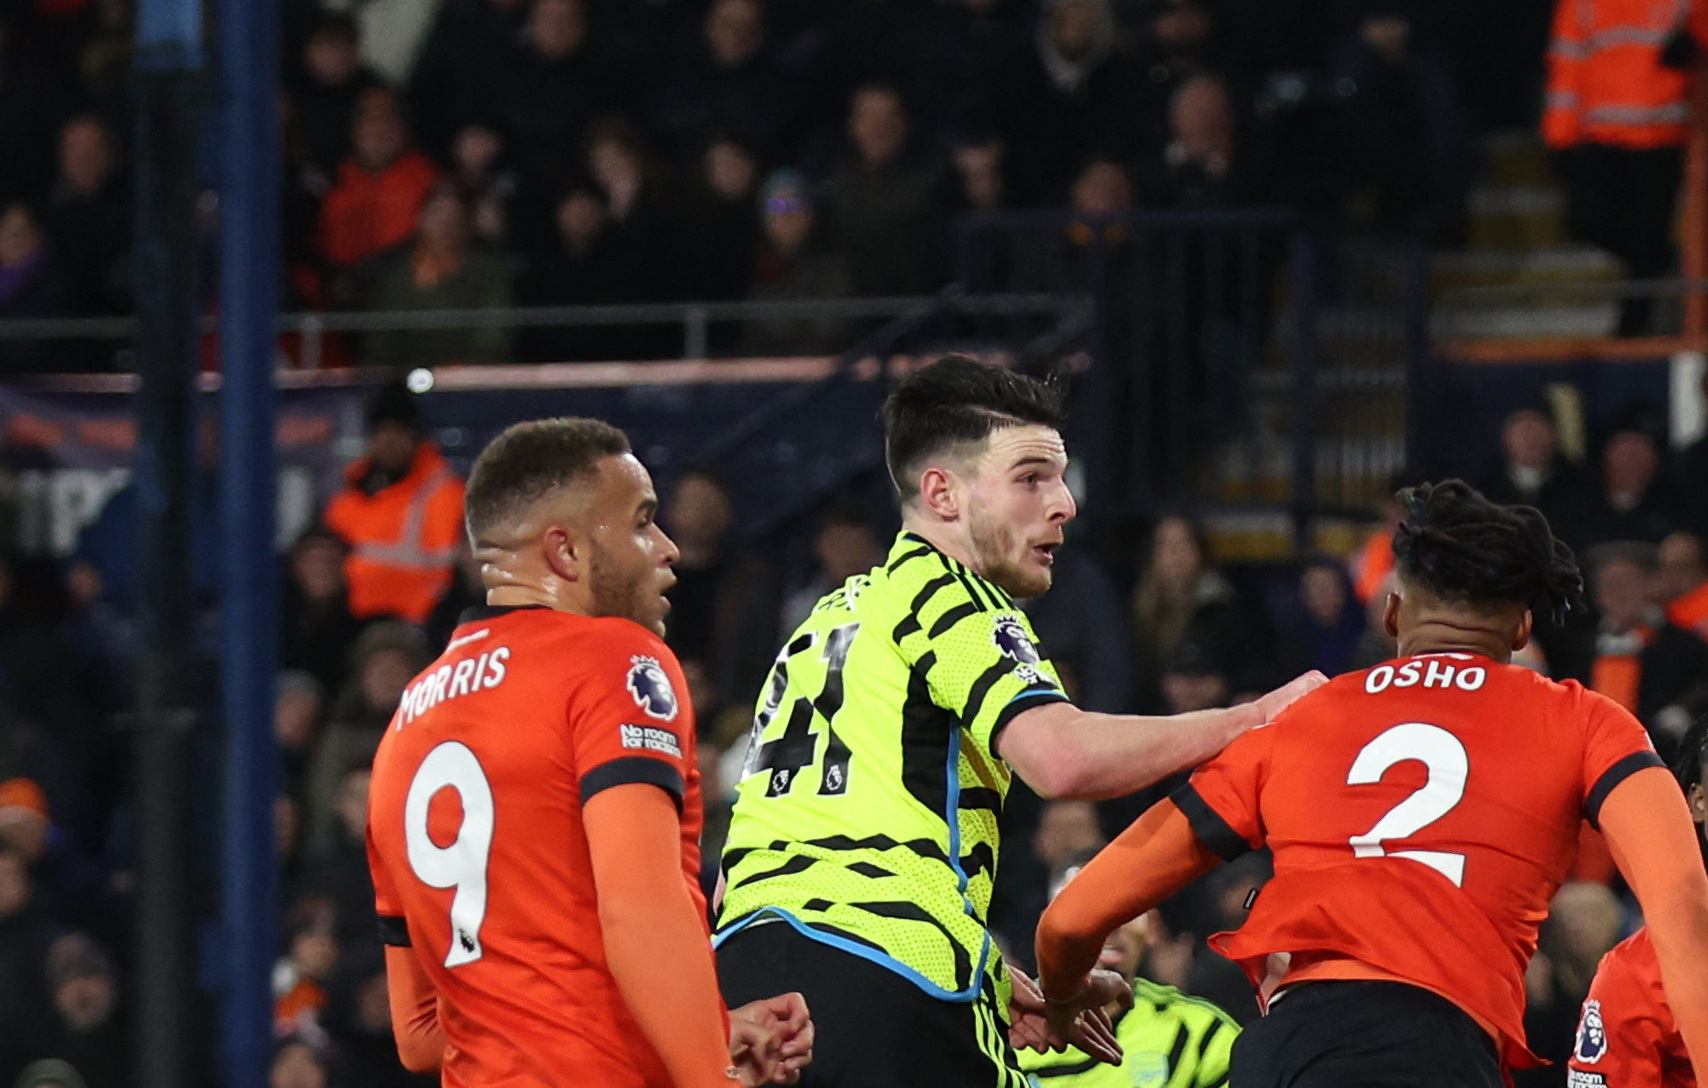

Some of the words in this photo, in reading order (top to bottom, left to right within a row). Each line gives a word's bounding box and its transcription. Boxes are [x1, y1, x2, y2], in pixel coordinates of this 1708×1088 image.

[395, 645, 511, 732] MORRIS
[620, 723, 643, 738] No
[643, 727, 678, 747] room
[743, 622, 862, 798] 41
[1364, 659, 1487, 694] OSHO
[404, 738, 495, 969] 9
[1346, 721, 1470, 889] 2
